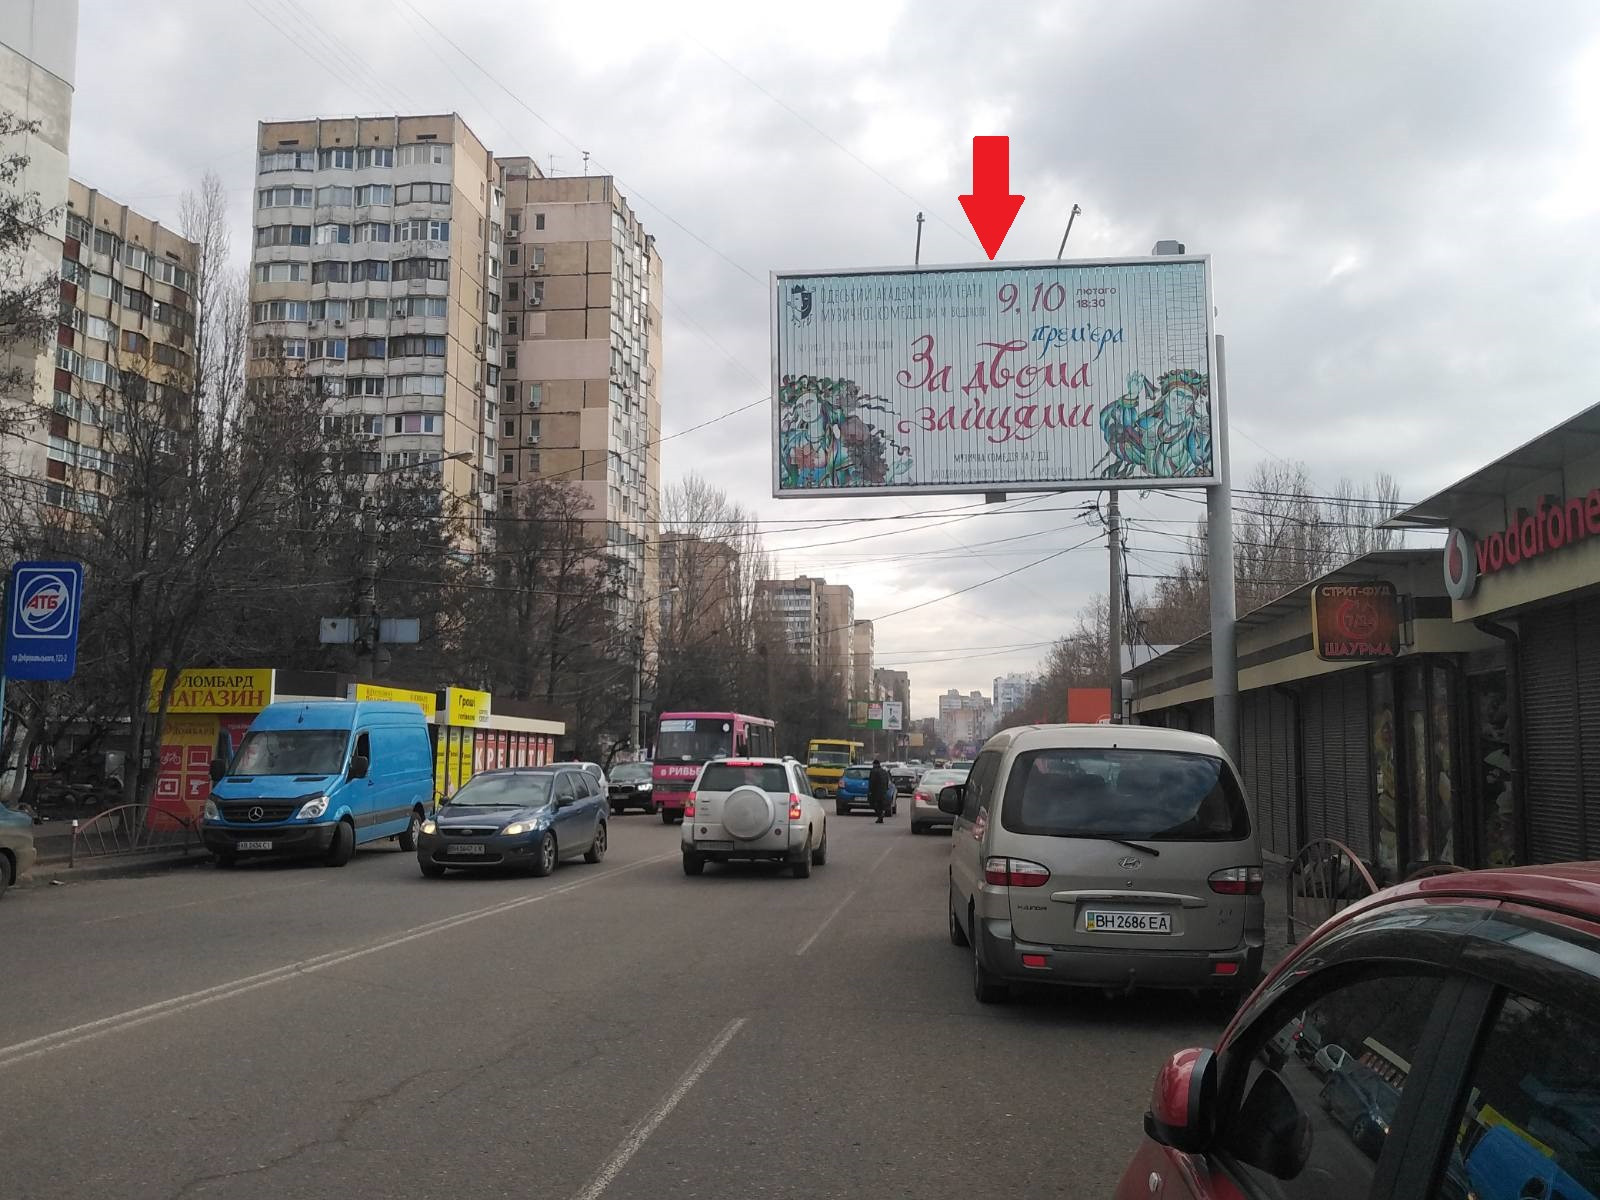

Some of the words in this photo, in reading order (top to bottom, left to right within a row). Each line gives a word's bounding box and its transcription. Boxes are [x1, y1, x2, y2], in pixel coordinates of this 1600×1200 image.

[1032, 282, 1066, 312] 10
[1076, 299, 1106, 308] 18:30
[896, 334, 954, 392] За
[961, 340, 1094, 399] двома
[897, 398, 1095, 443] зайцями
[1475, 488, 1600, 575] vodafone
[26, 595, 59, 609] АТБ
[1325, 642, 1393, 656] ШАУРМА
[181, 675, 254, 689] ЛОМБАРД
[1095, 914, 1115, 928] BH
[1117, 915, 1146, 929] 2686
[1149, 917, 1168, 930] EA
